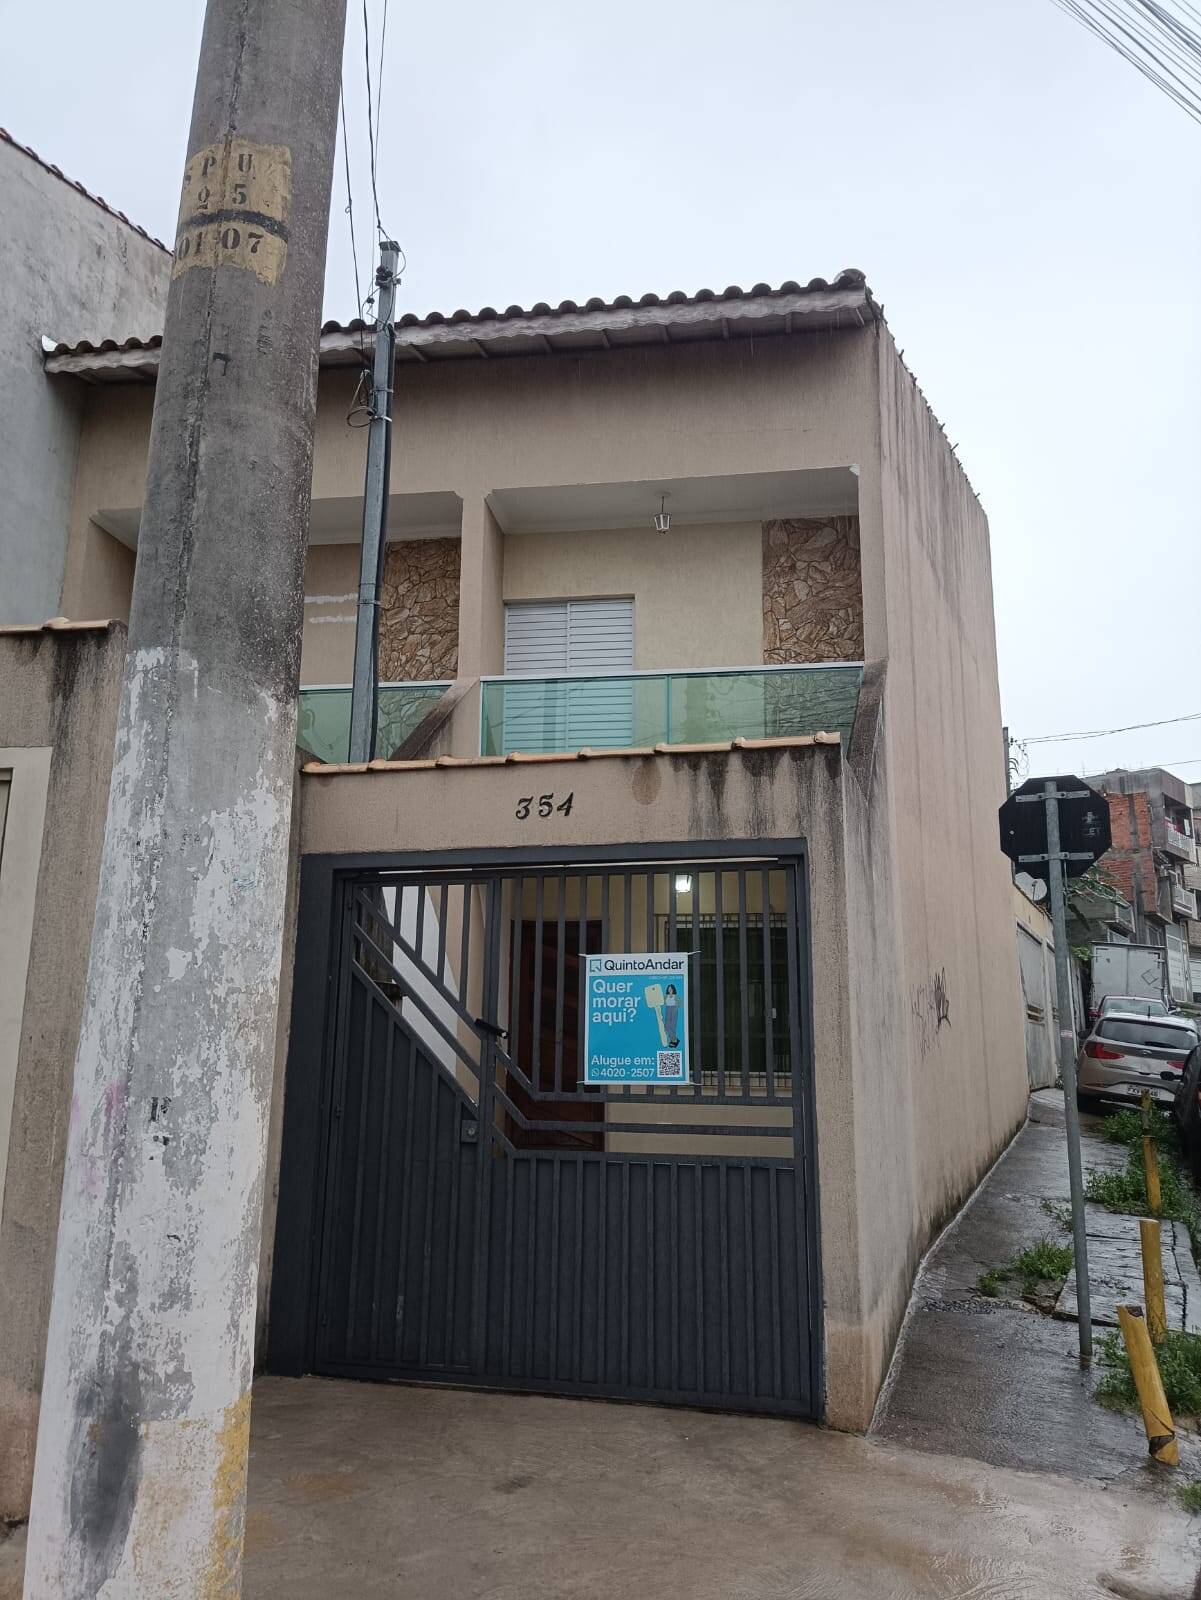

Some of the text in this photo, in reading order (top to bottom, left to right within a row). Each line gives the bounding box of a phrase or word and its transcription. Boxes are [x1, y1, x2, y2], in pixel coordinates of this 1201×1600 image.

[515, 791, 574, 820] 354
[604, 958, 685, 972] QuintoAndar
[592, 979, 634, 994] Quer
[592, 996, 641, 1008] morar
[592, 1008, 637, 1026] aqui?
[591, 1055, 655, 1068] Alugue em:
